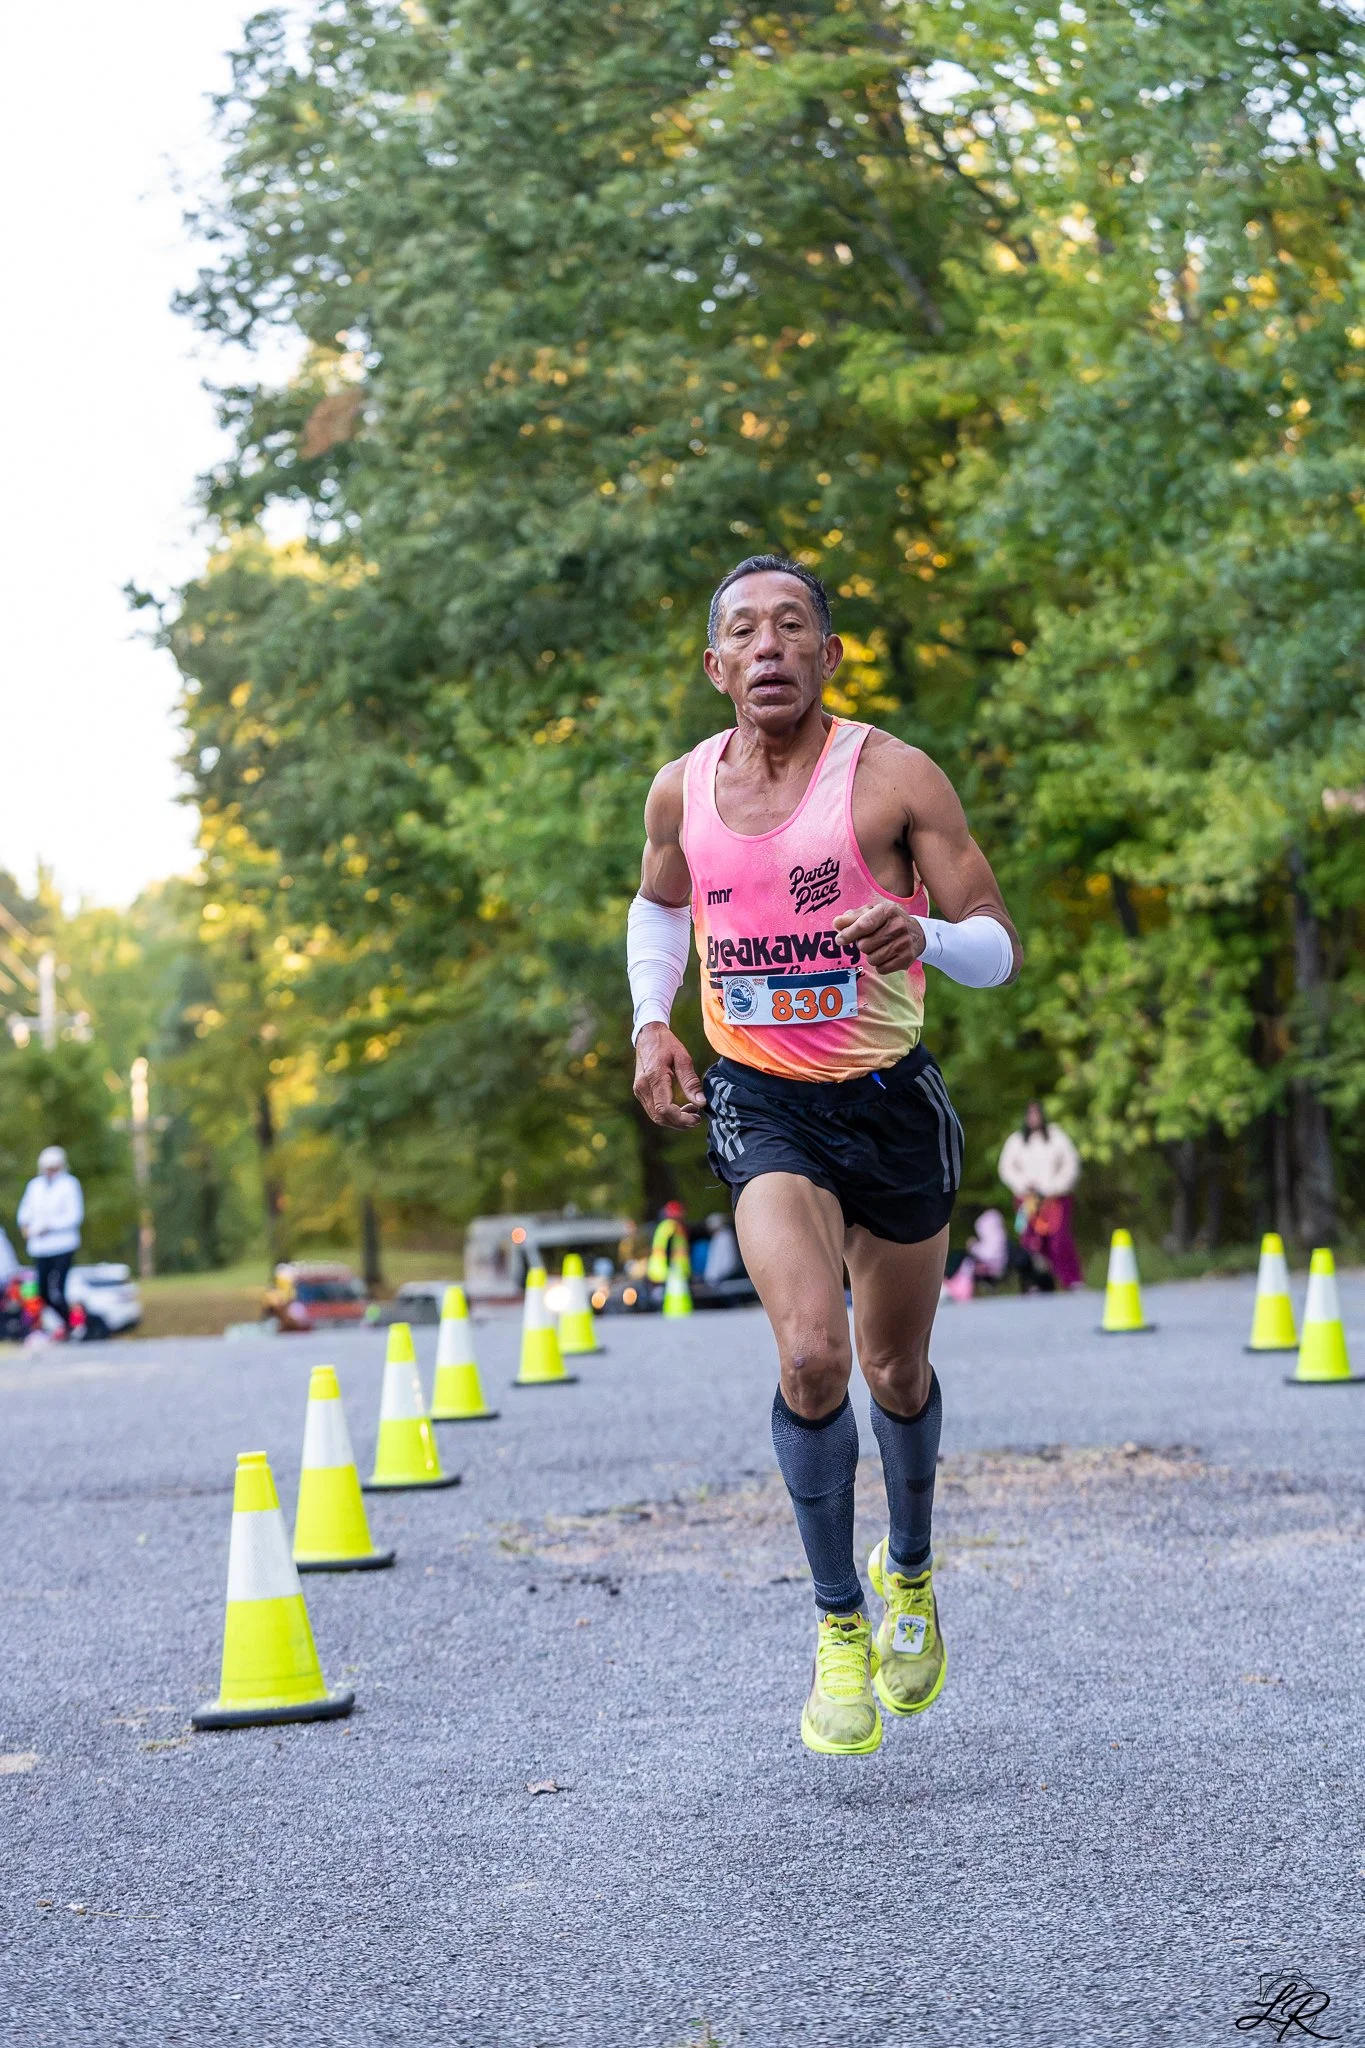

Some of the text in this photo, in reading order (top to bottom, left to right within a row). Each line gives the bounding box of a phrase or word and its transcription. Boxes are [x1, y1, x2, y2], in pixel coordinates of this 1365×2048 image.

[789, 856, 840, 895] Party
[795, 881, 841, 914] Pace
[772, 986, 843, 1021] 830
